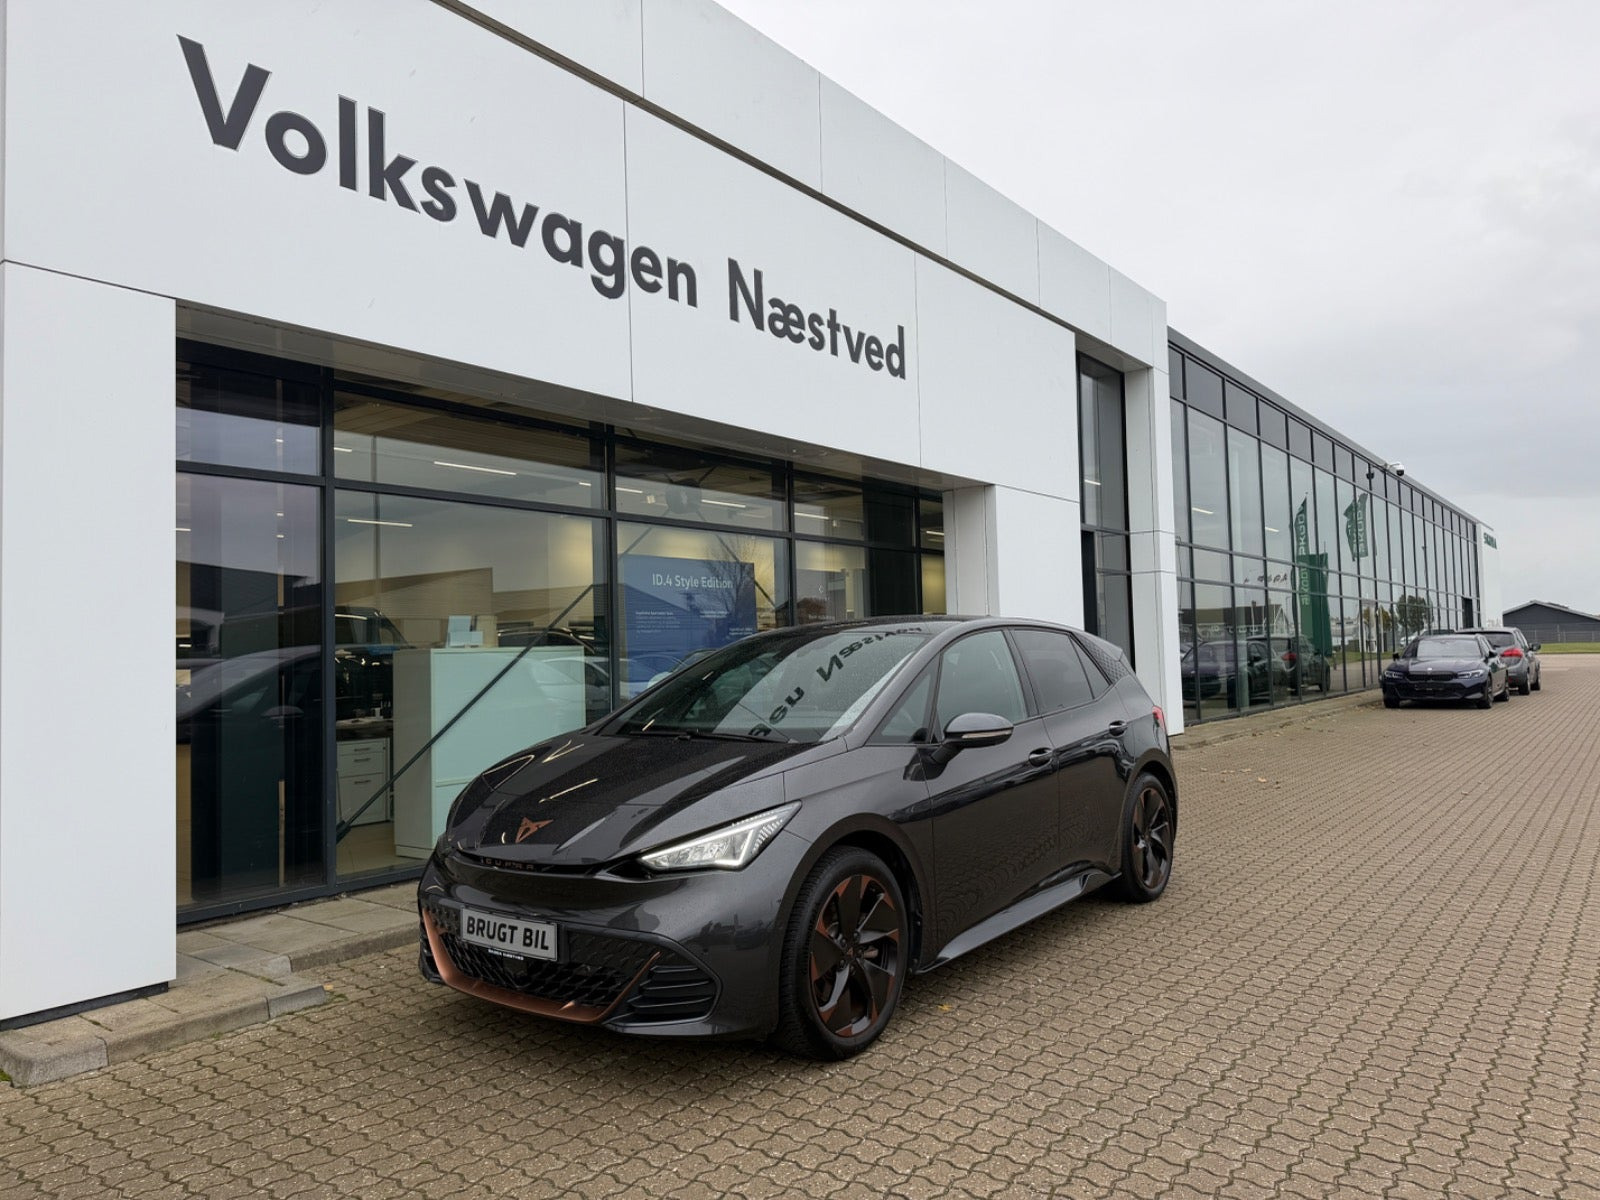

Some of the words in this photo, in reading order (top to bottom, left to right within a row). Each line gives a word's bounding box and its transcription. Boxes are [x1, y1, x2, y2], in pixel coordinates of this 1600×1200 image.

[177, 34, 697, 308] Volkswagen
[728, 257, 905, 380] Næstved
[652, 573, 672, 587] ID.4
[675, 575, 699, 590] Style
[701, 576, 733, 589] Edition
[467, 916, 518, 944] BRUGT
[522, 928, 549, 950] BIL
